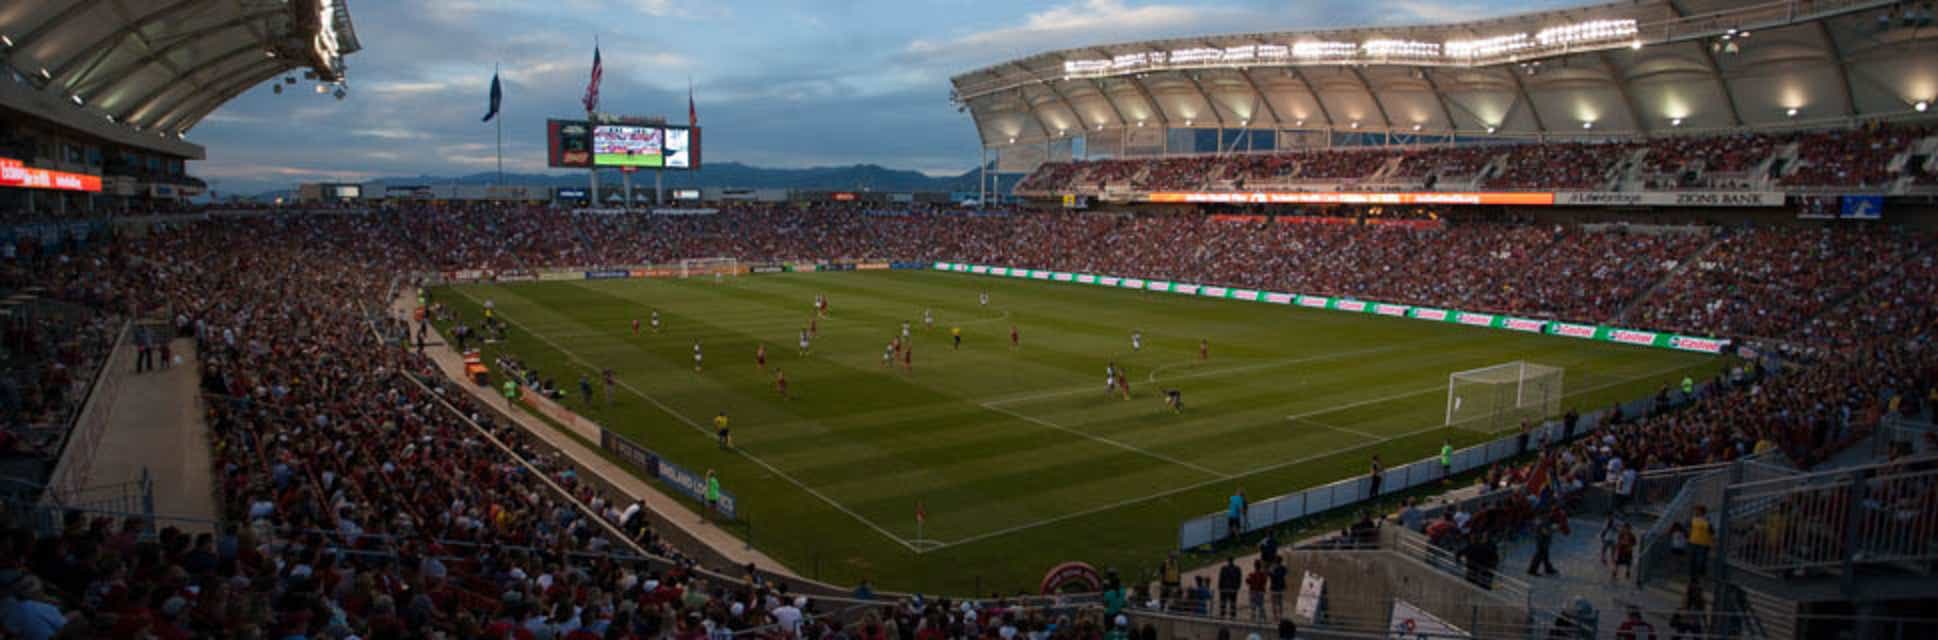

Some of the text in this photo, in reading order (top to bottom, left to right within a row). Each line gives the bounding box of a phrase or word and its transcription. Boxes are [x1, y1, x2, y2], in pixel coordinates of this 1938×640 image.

[1677, 193, 1763, 205] ZIONS BANK
[1558, 323, 1593, 337] Castrol
[1615, 329, 1653, 343] Castrol
[1679, 336, 1720, 351] Castrol
